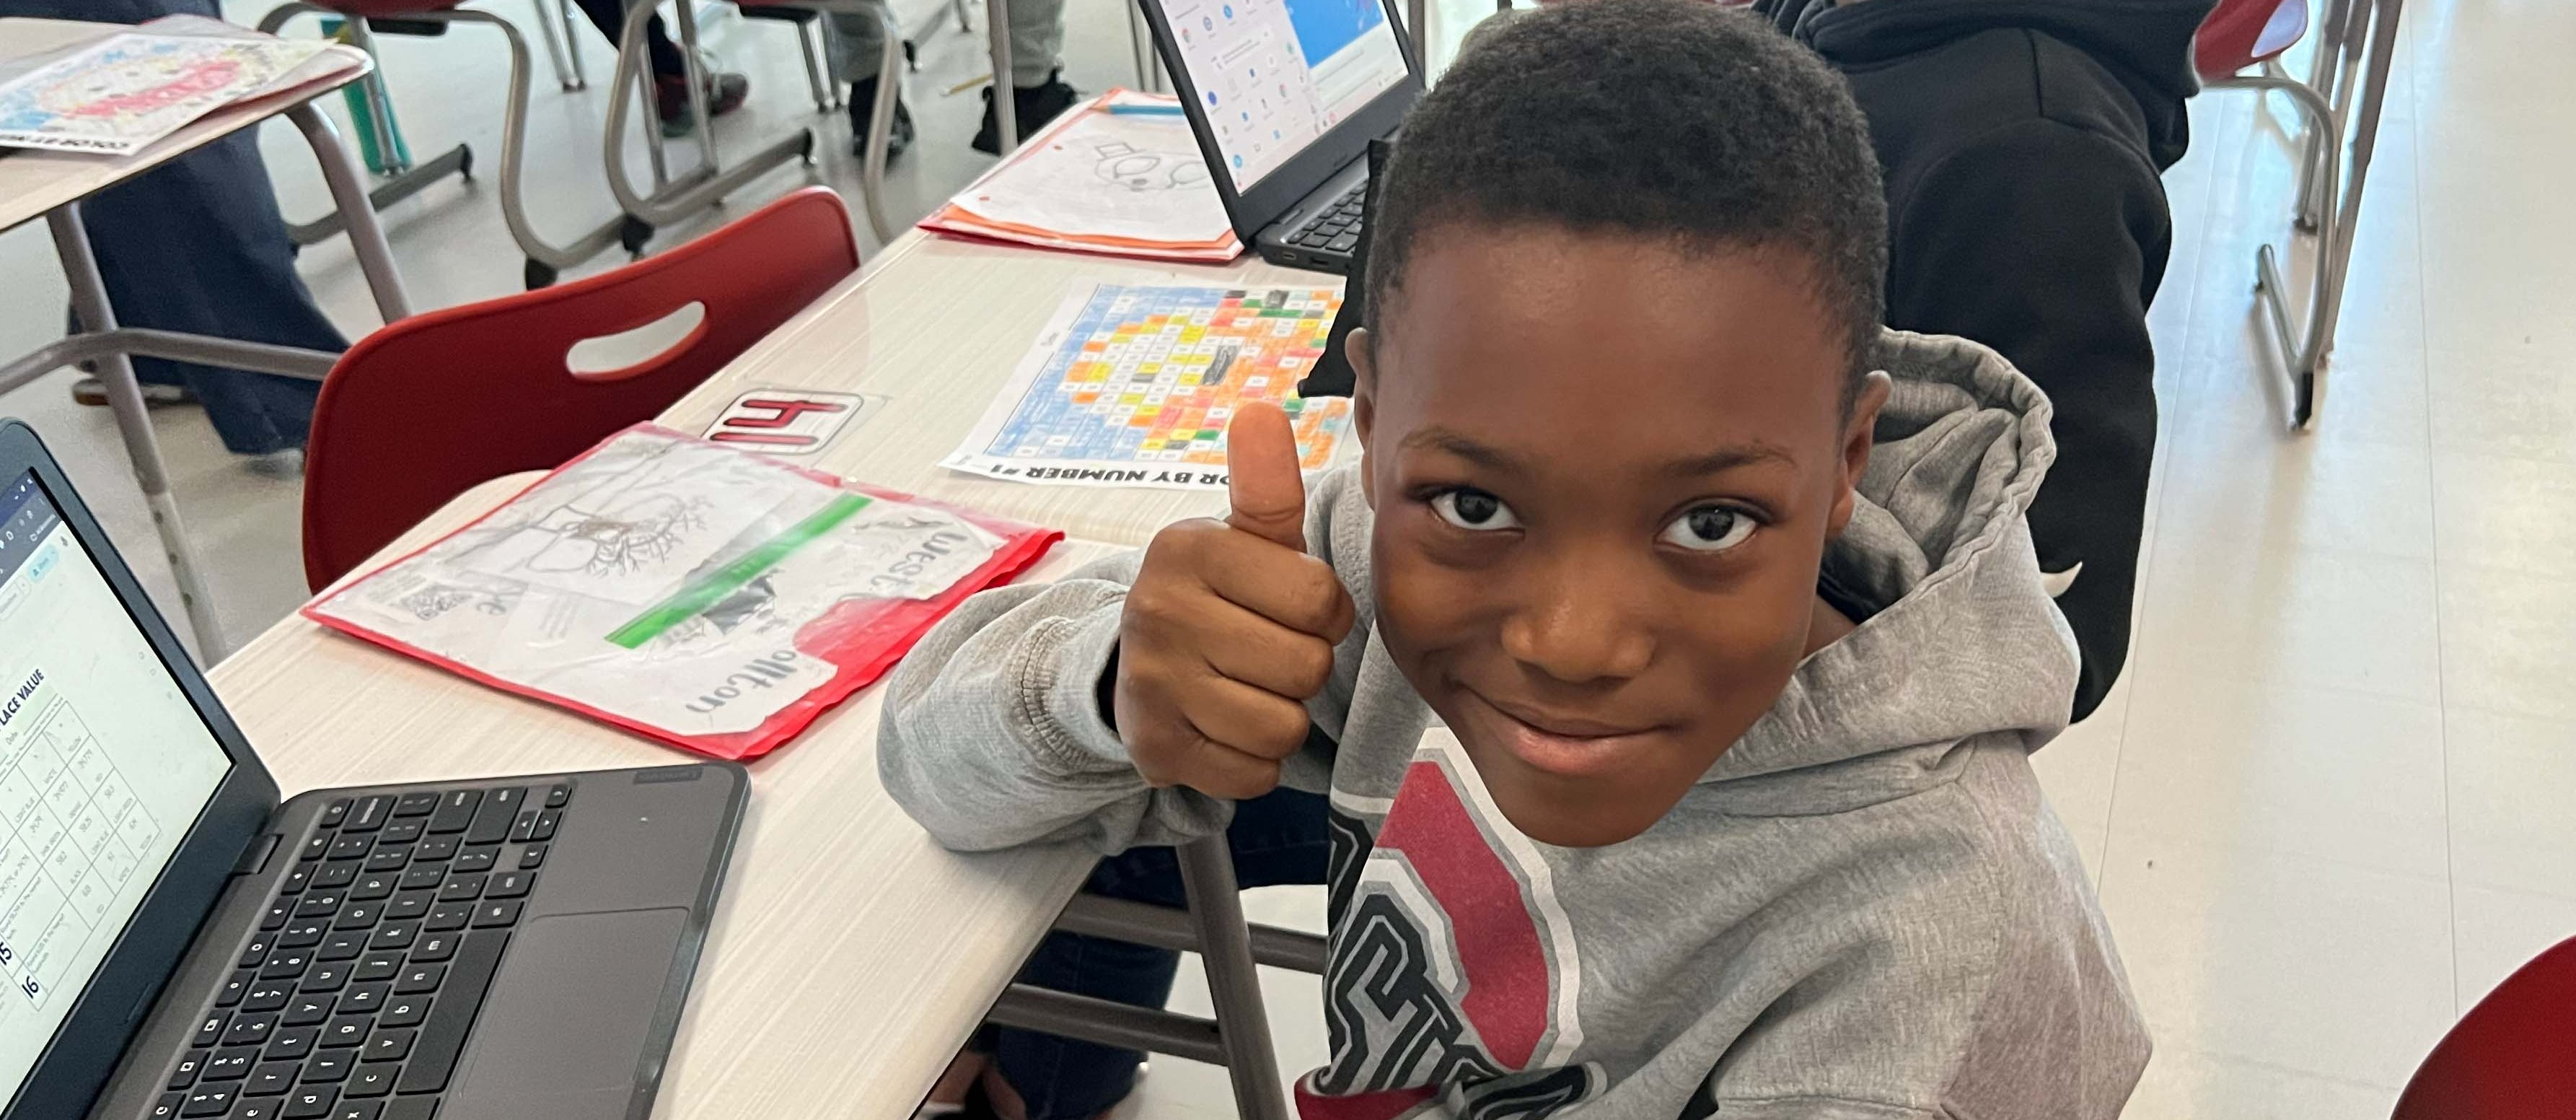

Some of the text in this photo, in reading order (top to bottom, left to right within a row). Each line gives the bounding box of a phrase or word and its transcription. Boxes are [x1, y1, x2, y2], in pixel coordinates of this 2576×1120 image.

[709, 398, 850, 445] 14
[1024, 465, 1149, 482] NUMBER
[1150, 471, 1195, 484] BY
[0, 668, 44, 726] LACE VALUE
[691, 649, 798, 714] ollton
[22, 975, 39, 999] 16
